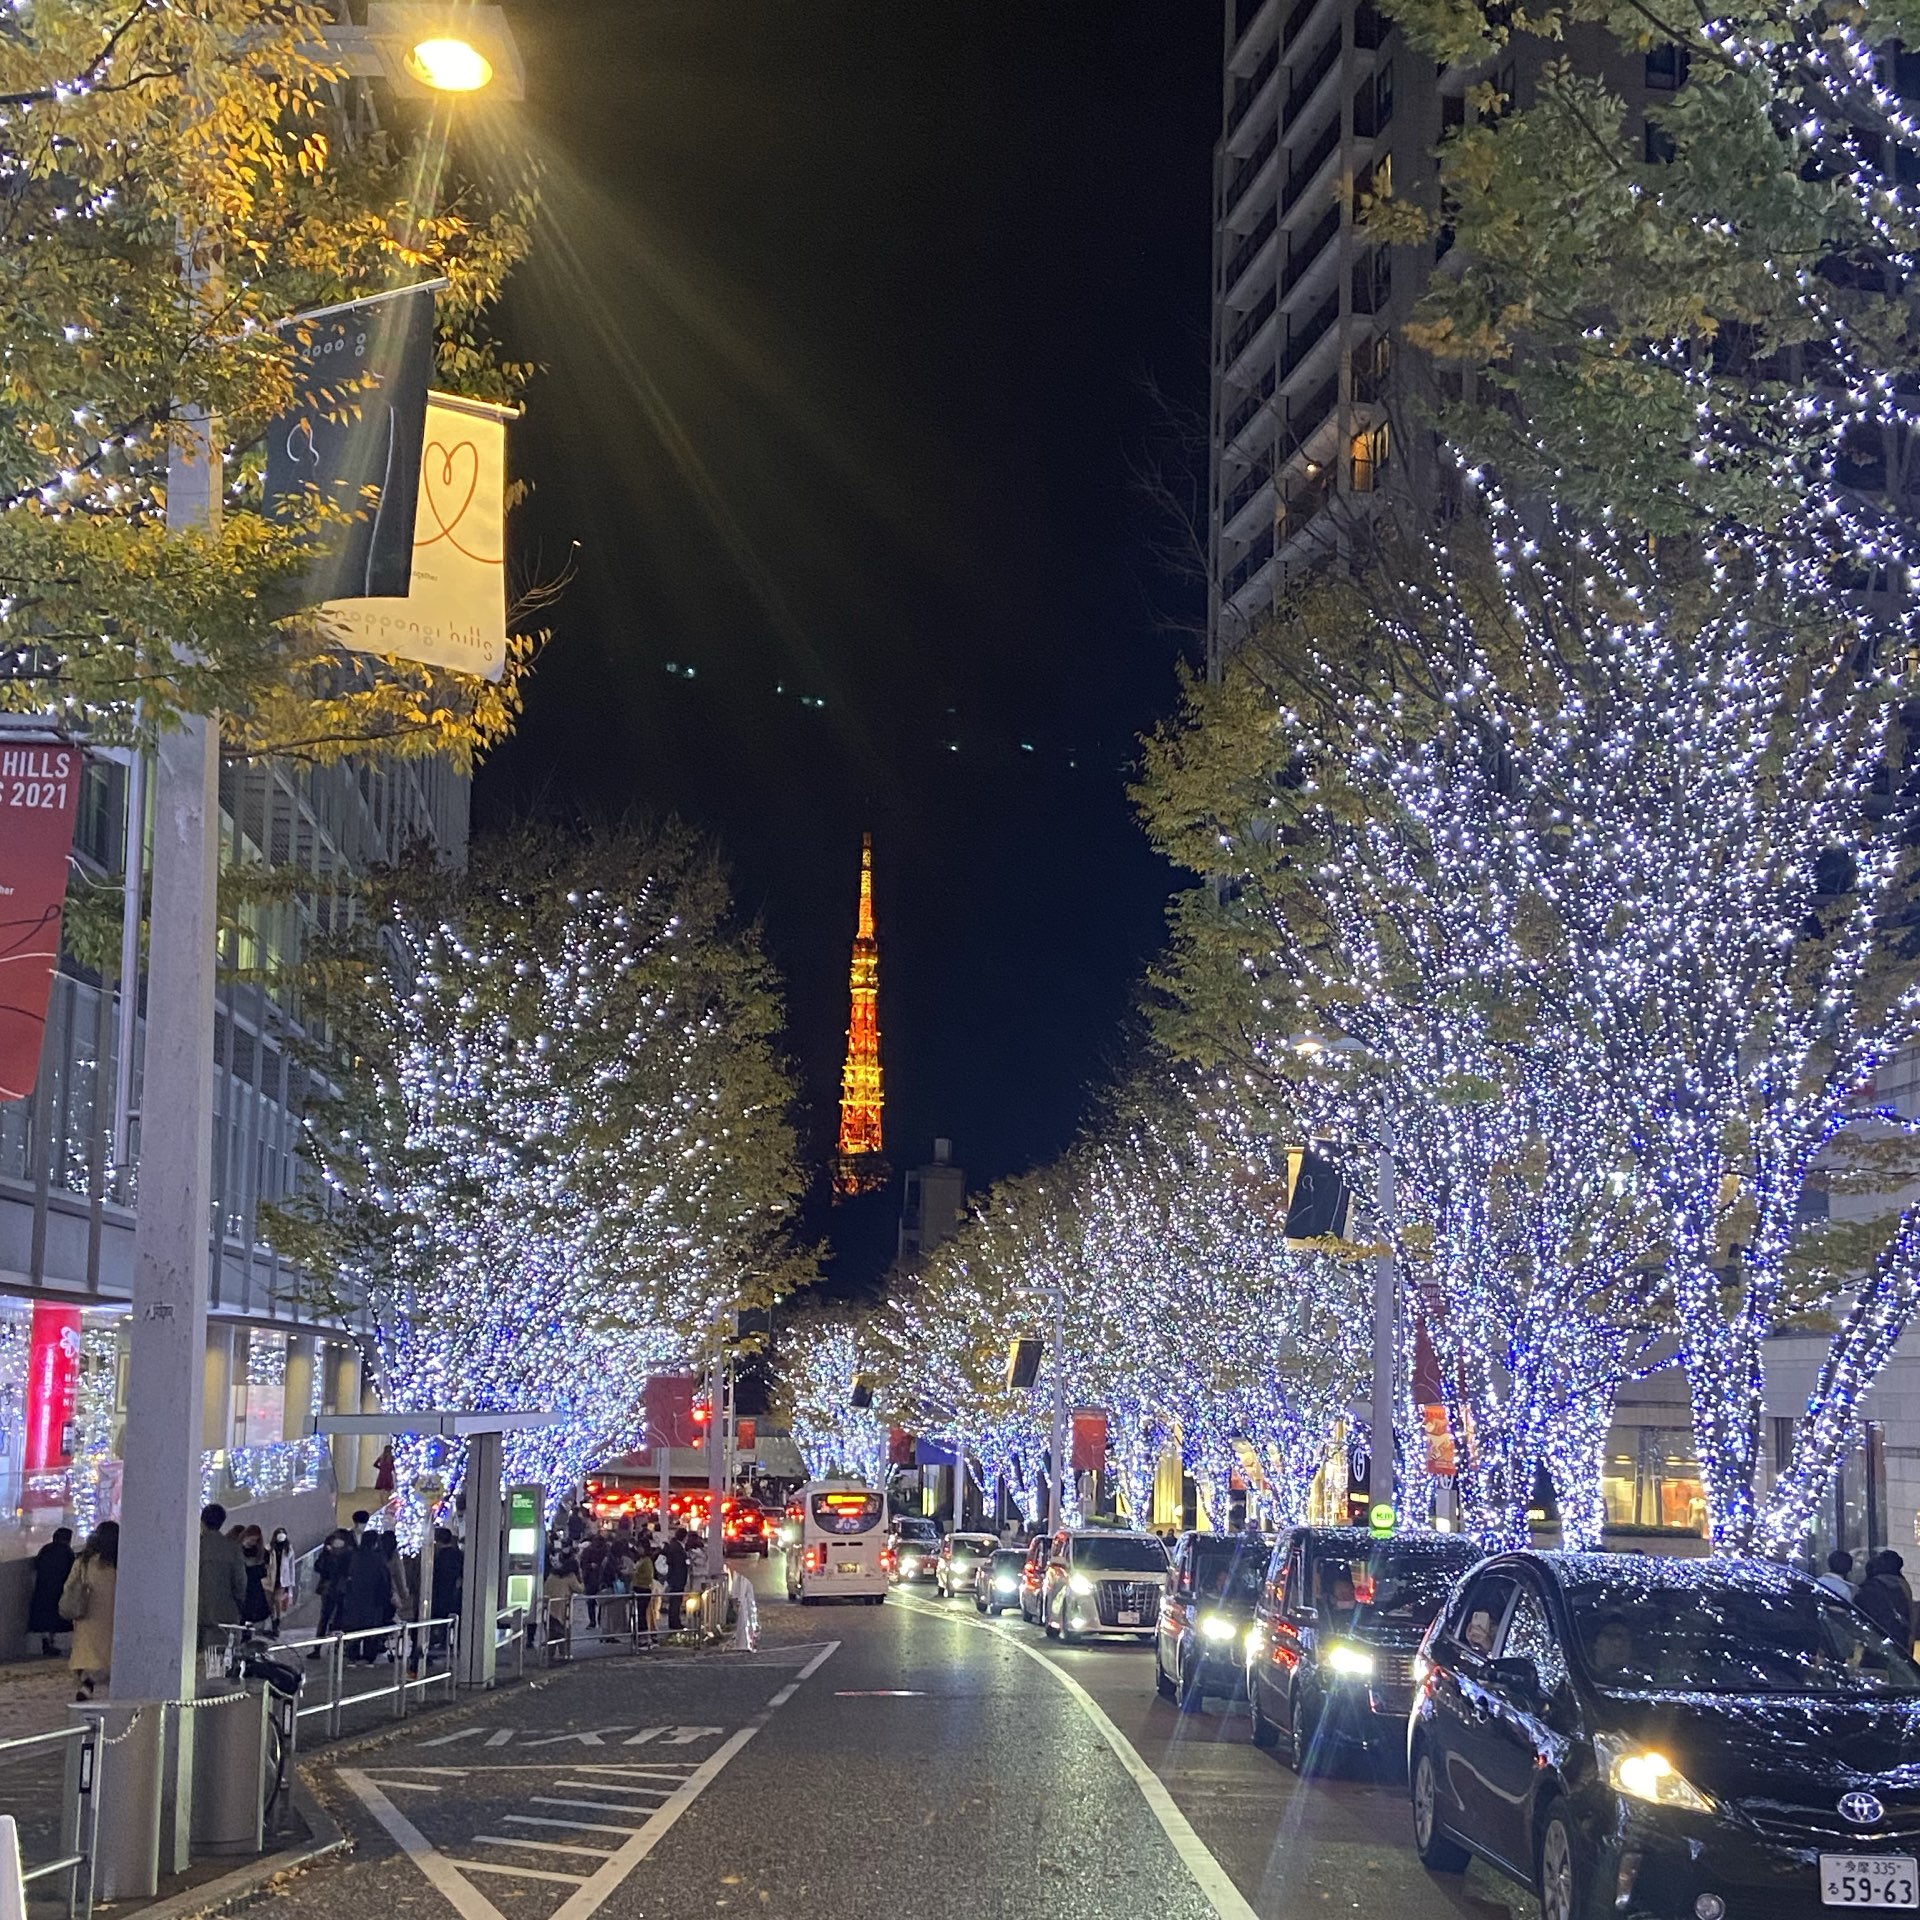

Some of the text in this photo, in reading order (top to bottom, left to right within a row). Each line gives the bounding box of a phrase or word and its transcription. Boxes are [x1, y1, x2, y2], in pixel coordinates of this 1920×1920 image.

[450, 620, 493, 662] hills
[2, 751, 70, 779] HILLS
[10, 782, 67, 809] 2021
[1872, 1861, 1896, 1876] 335
[1842, 1876, 1912, 1905] 59-63
